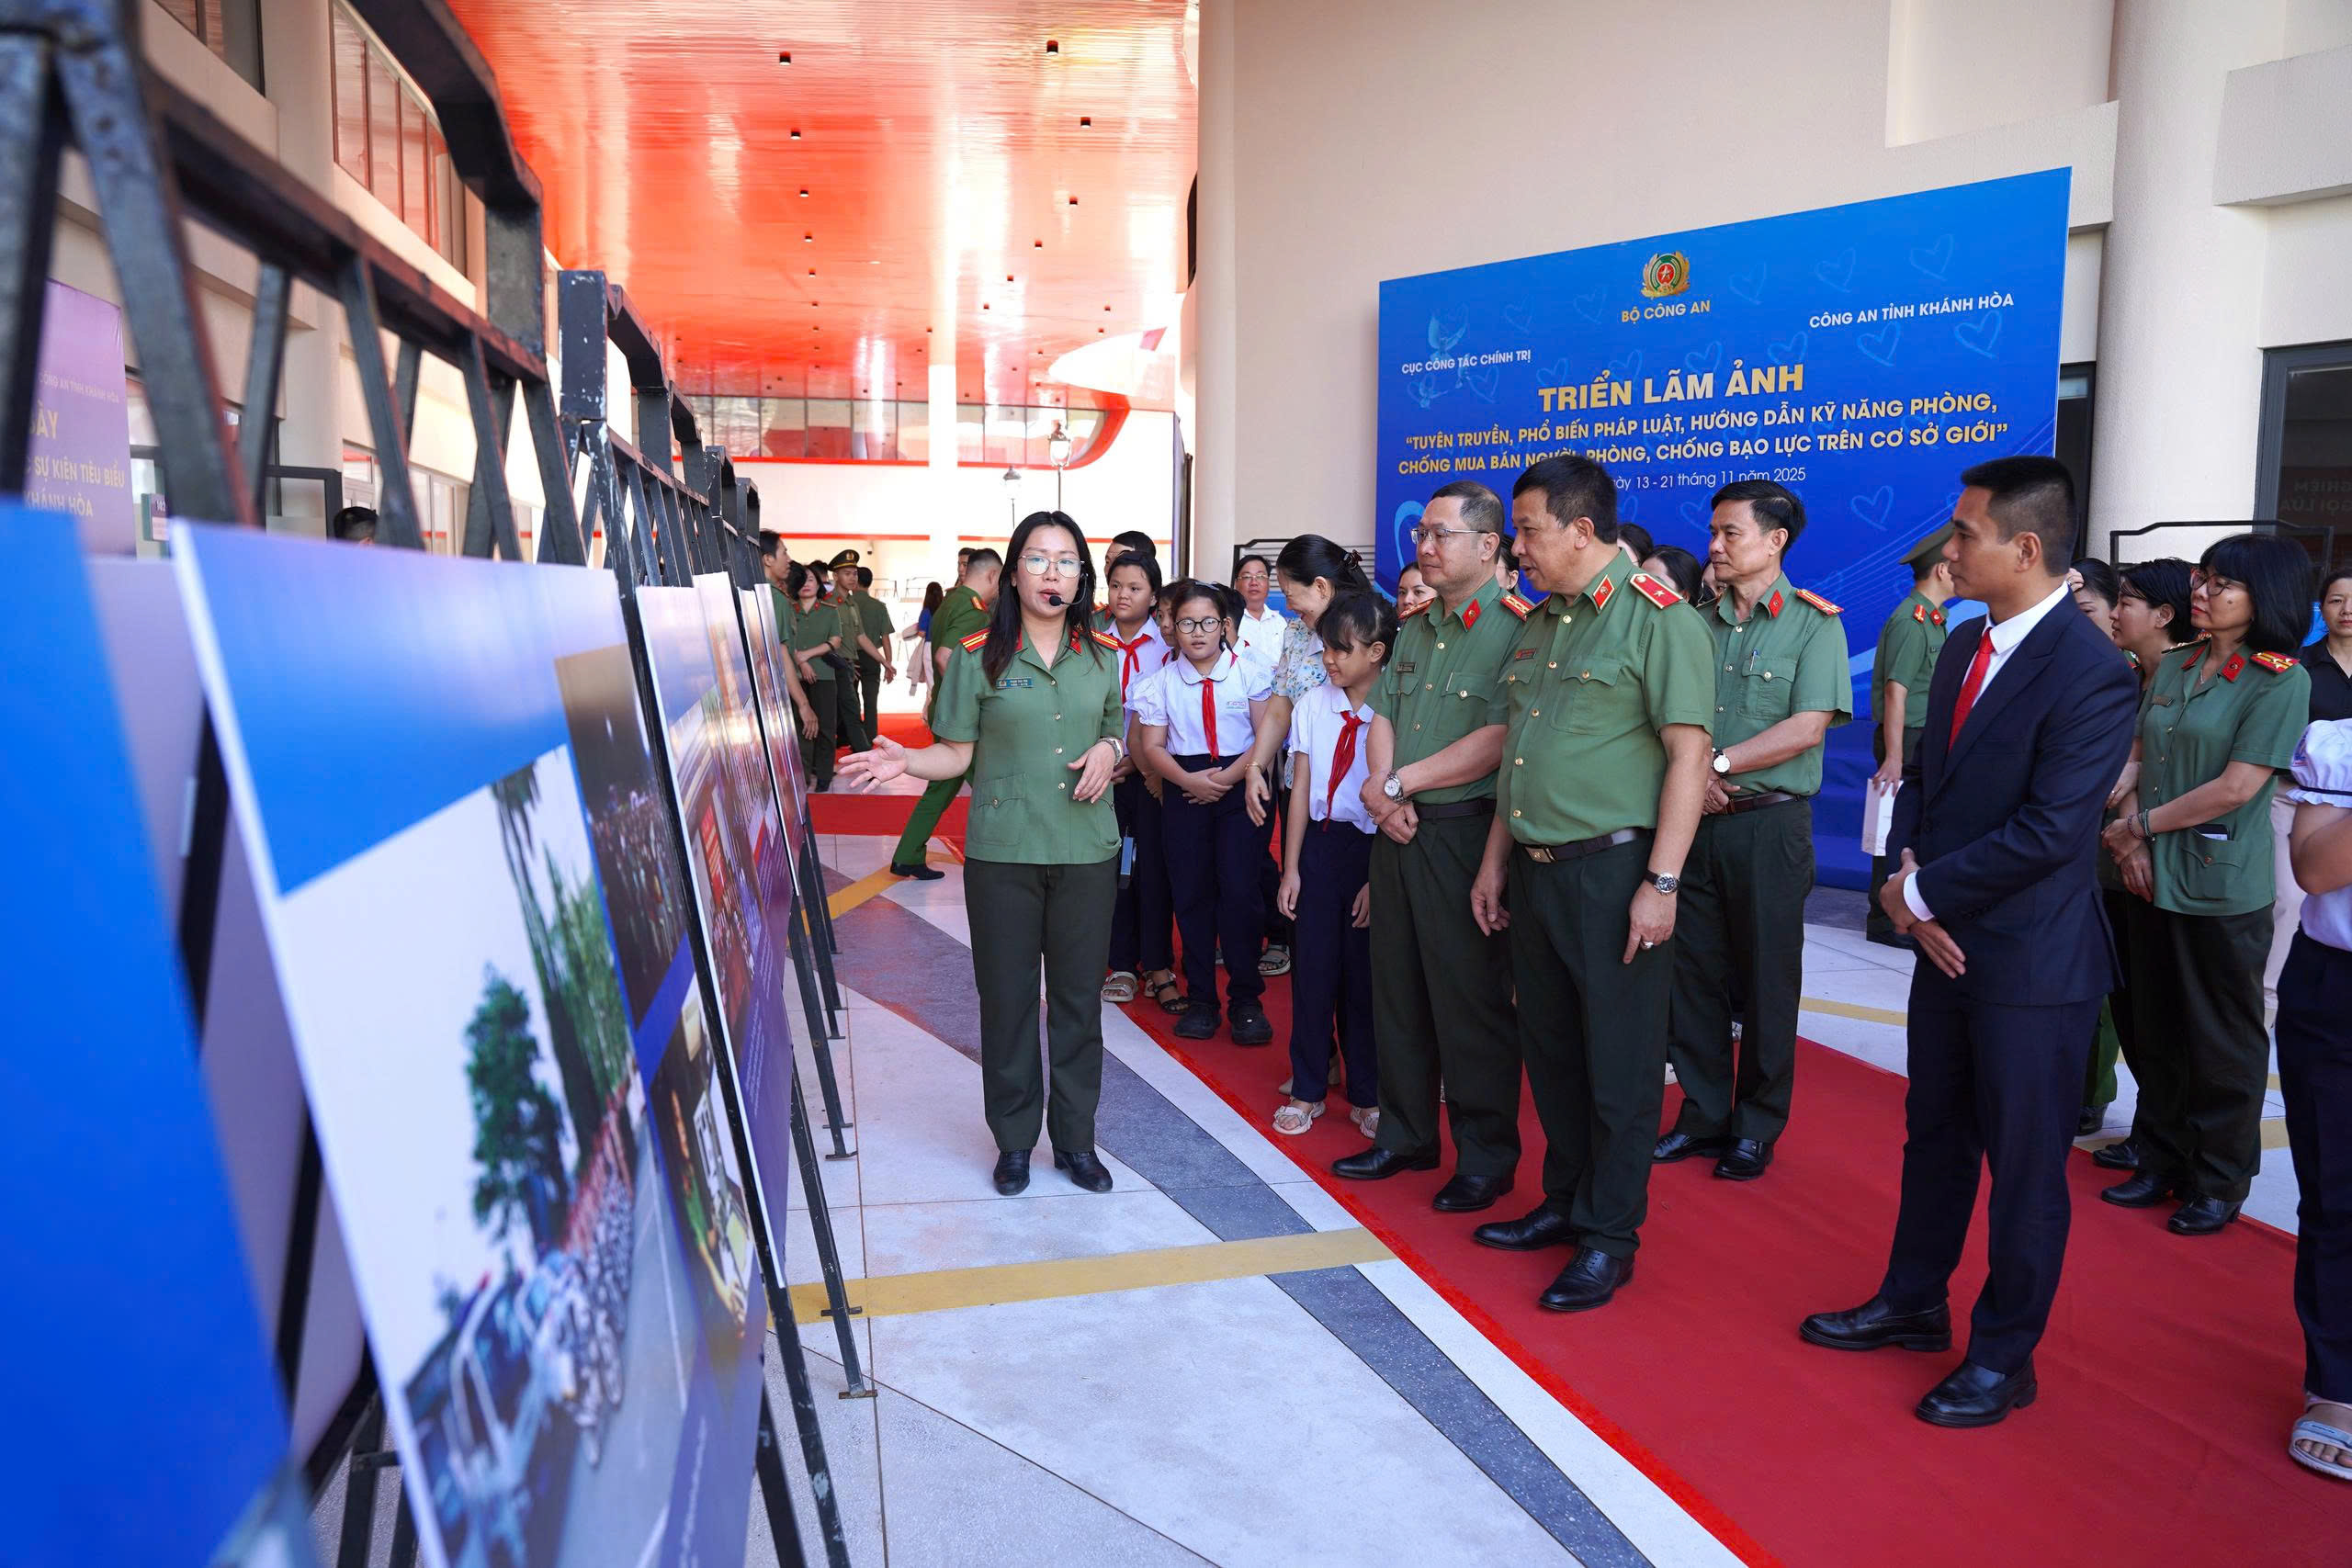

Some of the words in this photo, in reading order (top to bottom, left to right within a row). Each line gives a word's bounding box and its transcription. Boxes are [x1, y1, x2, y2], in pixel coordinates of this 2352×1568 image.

[1622, 307, 1640, 323] BỘ
[1644, 301, 1686, 320] CÔNG
[1690, 300, 1711, 314] AN
[1809, 310, 1853, 329] CÔNG
[1857, 308, 1878, 323] AN
[1882, 303, 1915, 321] TỈNH
[1919, 296, 1973, 316] KHÁNH
[1978, 290, 2014, 309] HÒA
[1401, 362, 1423, 376] CỤC
[1425, 356, 1456, 372] CÔNG
[1457, 352, 1478, 368] TÁC
[1480, 351, 1513, 367] CHÍNH
[1516, 349, 1532, 364] TRỊ
[1537, 369, 1632, 412] TRIỂN
[1643, 369, 1714, 404] LÃM
[1724, 359, 1804, 397] ẢNH
[1406, 433, 1453, 451] “TUYÊN
[1457, 423, 1514, 447] TRUYỀN,
[1519, 419, 1551, 443] PHỔ
[1555, 417, 1589, 441] BIẾN
[1594, 415, 1637, 437] PHÁP
[1642, 413, 1685, 438] LUẬT,
[1690, 408, 1758, 431] HƯỚNG
[1764, 400, 1804, 426] DẪN
[1811, 403, 1838, 423] KỸ
[1842, 398, 1904, 421] NĂNG
[1910, 390, 1998, 416] PHÒNG,
[1398, 452, 1451, 475] CHỐNG
[1454, 456, 1486, 472] MUA
[1490, 450, 1521, 469] BÁN
[1587, 443, 1651, 464] PHÒNG,
[1656, 435, 1724, 459] CHỐNG
[1729, 440, 1770, 459] BẠO
[1775, 435, 1812, 458] LỰC
[1817, 429, 1863, 451] TRÊN
[1870, 428, 1904, 448] CƠ
[1910, 422, 1939, 446] SỞ
[1945, 421, 2008, 444] GIỚI”
[1636, 476, 1650, 489] 13
[1660, 475, 1673, 489] 21
[1678, 472, 1716, 489] tháng
[1722, 470, 1734, 484] 11
[1773, 467, 1807, 483] 2025
